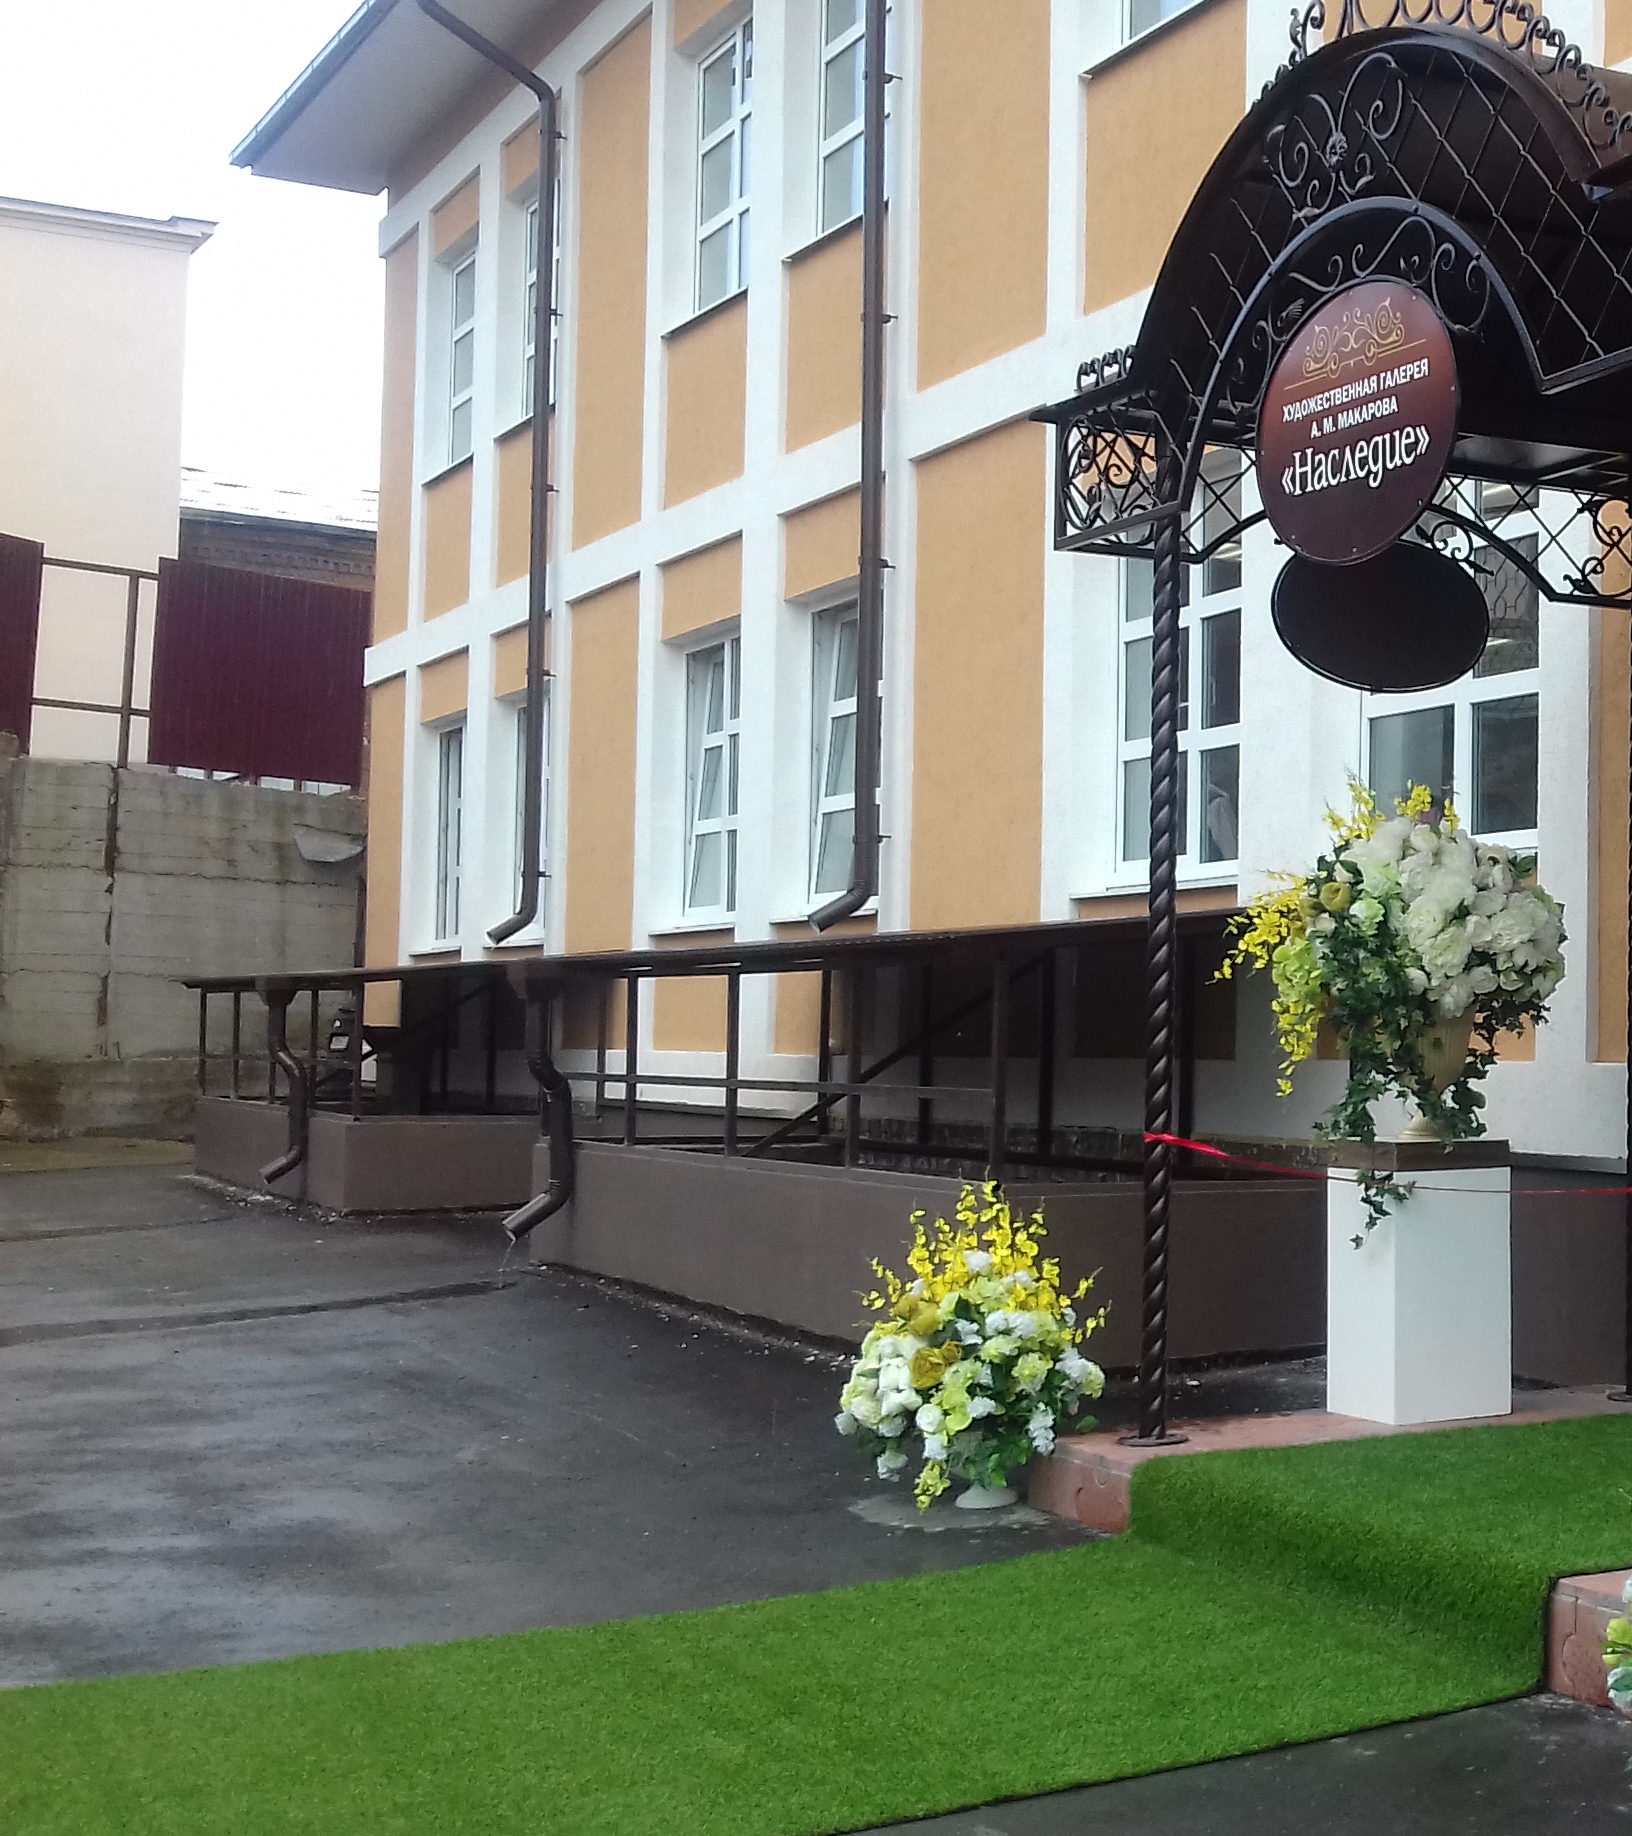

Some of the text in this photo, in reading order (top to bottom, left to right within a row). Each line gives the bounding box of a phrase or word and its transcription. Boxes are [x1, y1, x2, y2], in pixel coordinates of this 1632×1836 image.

[1282, 358, 1429, 422] ХУДОЖЕСТВЕННАЯ ГАЛЕРЕЯ
[1310, 396, 1398, 439] А. М. МАКАРОВА
[1281, 425, 1430, 496] «Наследие»
